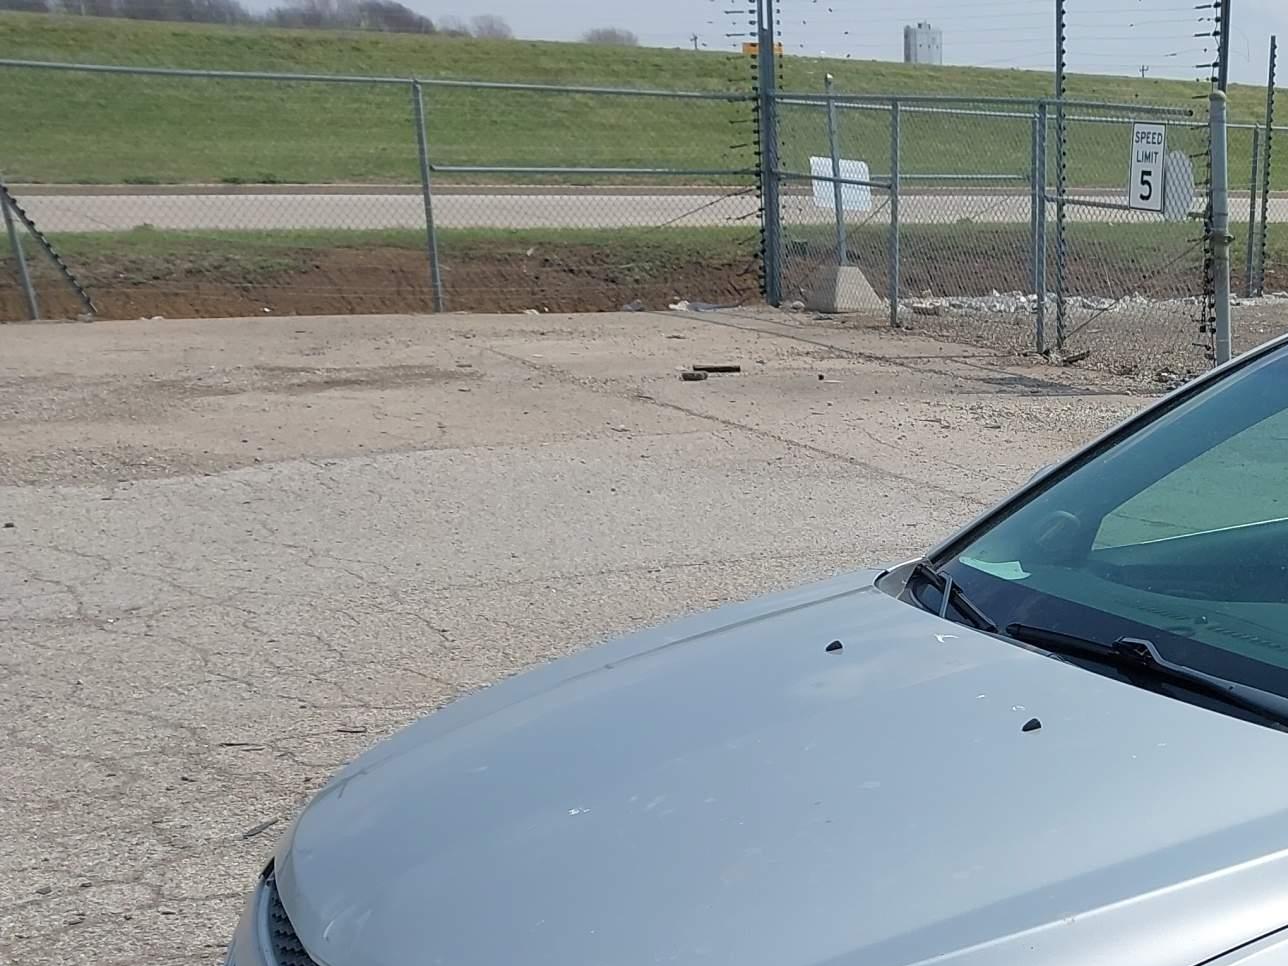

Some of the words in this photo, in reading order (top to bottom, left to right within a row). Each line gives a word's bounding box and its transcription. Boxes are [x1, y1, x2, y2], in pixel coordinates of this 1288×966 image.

[1135, 131, 1163, 145] SPEED
[1136, 151, 1159, 164] LIMIT
[1139, 170, 1153, 201] 5
